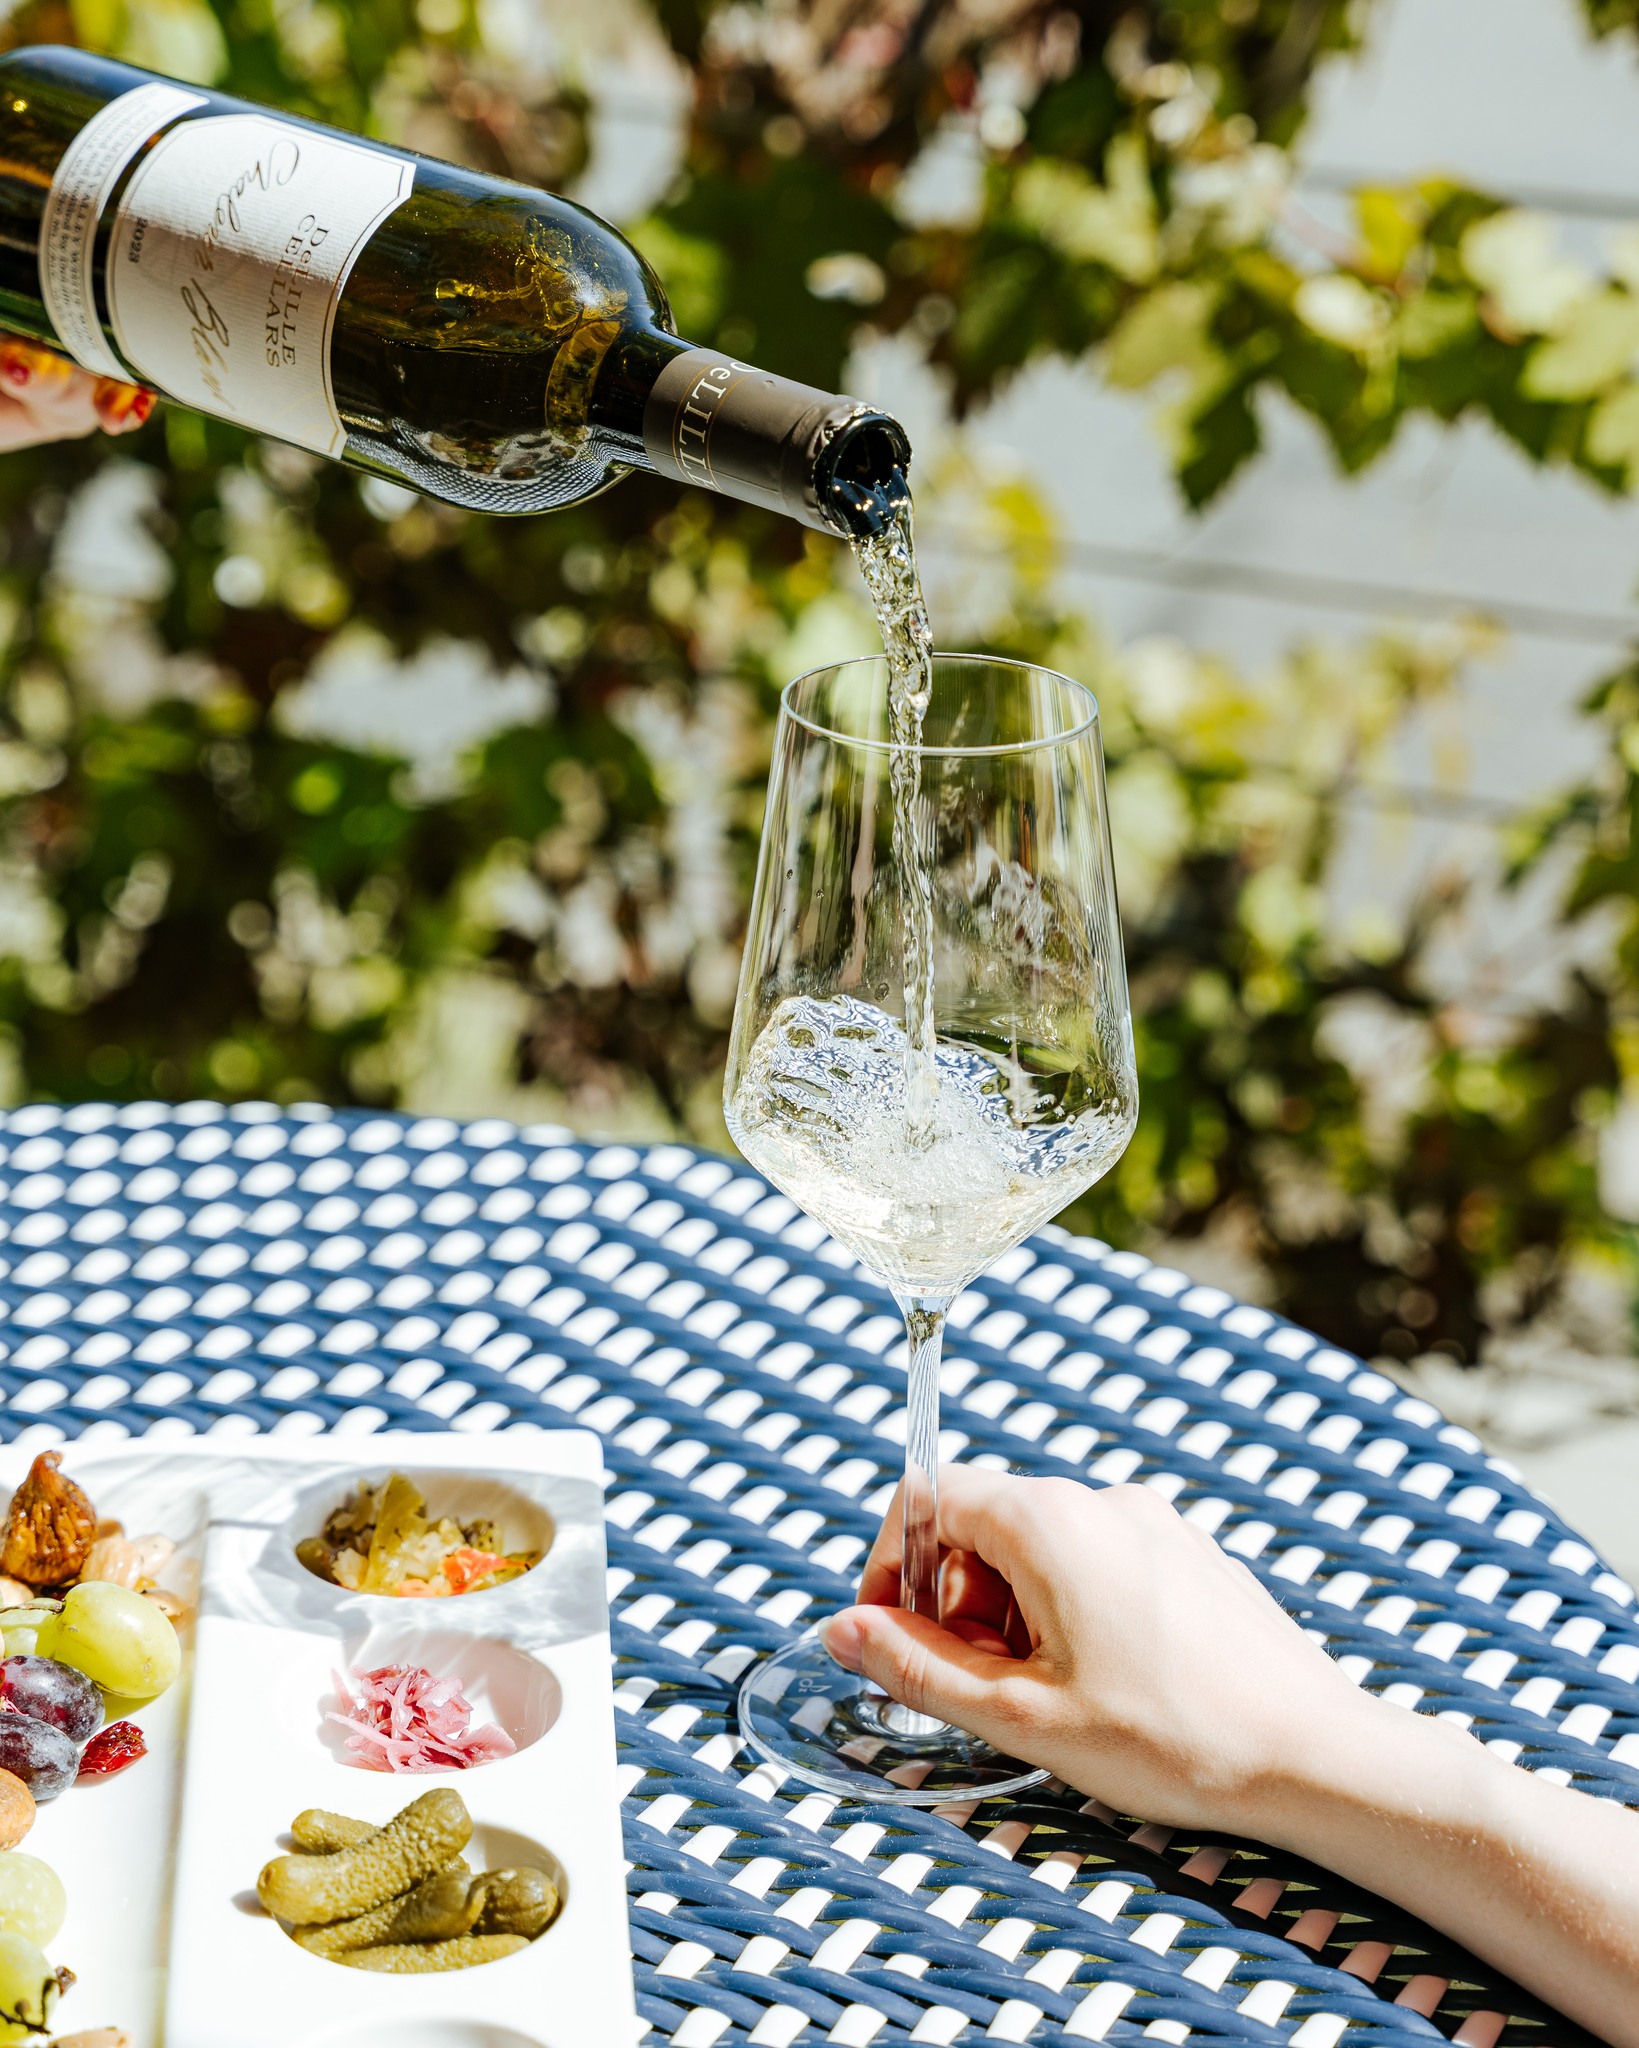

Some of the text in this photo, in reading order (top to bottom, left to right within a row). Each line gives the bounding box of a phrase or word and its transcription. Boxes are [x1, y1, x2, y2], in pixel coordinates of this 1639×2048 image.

[127, 216, 149, 264] 2023
[266, 214, 316, 368] CELLARS
[282, 226, 330, 366] DeLILLE
